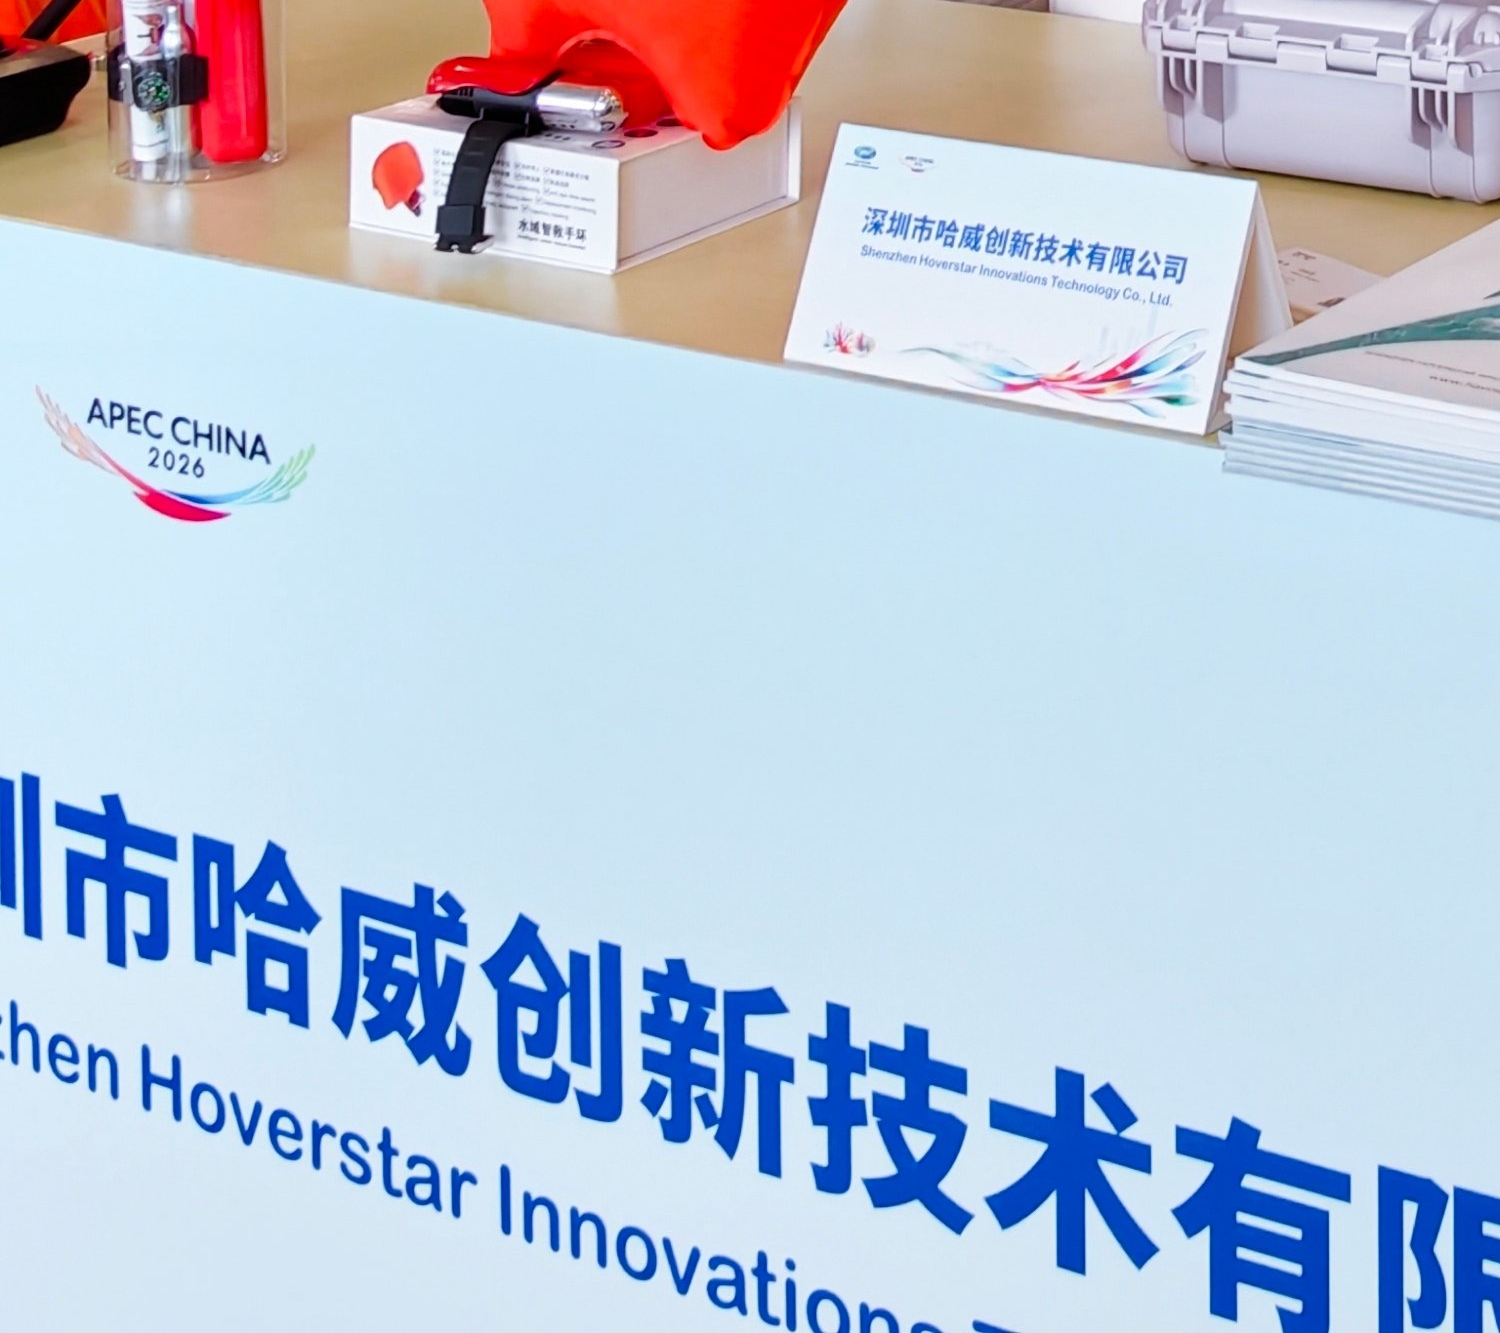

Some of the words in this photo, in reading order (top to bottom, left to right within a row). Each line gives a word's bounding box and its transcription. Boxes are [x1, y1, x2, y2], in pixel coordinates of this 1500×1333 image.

[860, 244, 918, 265] Shenzhen
[919, 254, 978, 275] Hoverstar
[979, 263, 1048, 286] Innovations
[1051, 275, 1121, 301] Technology
[1122, 286, 1147, 305] Co.,
[1149, 291, 1174, 308] Ltd.
[861, 206, 1189, 285] 深圳市哈威创新技术有限公司
[87, 397, 164, 440] APEC
[171, 416, 272, 465] CHINA
[148, 446, 206, 479] 2026
[0, 999, 119, 1101] hen
[141, 1043, 479, 1219] Hoverstar
[499, 1164, 945, 1333] Innovation
